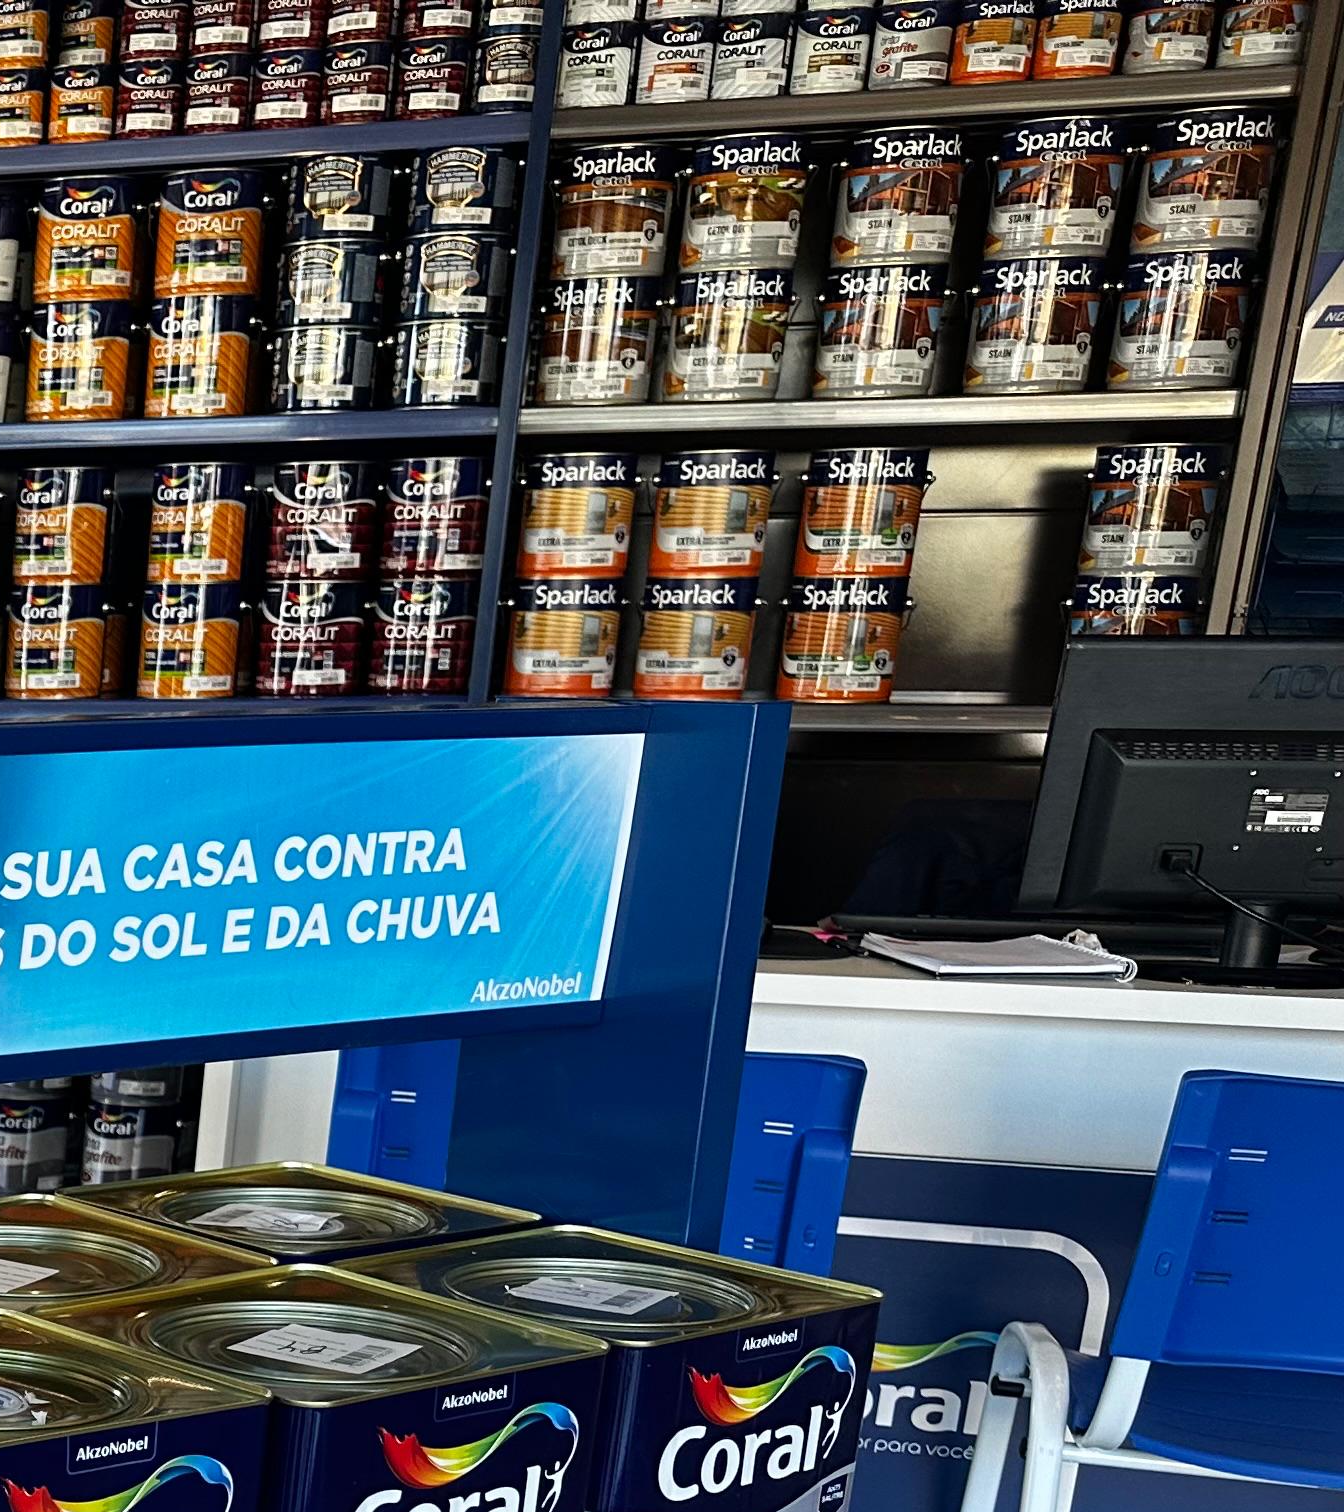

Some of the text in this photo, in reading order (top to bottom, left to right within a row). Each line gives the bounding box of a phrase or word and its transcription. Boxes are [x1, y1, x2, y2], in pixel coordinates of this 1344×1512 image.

[404, 65, 451, 82] CORALIT
[1015, 124, 1114, 156] Sparlack
[1176, 114, 1276, 148] Sparlack
[572, 151, 657, 182] Sparlack
[711, 139, 801, 170] Sparlack
[59, 195, 112, 216] Coral
[184, 187, 232, 209] Coral
[50, 221, 121, 242] CORALIT
[175, 215, 245, 235] CORALIT
[540, 459, 627, 487] Sparlack
[0, 847, 106, 900] SUA
[122, 837, 258, 892] CASA
[273, 826, 467, 882] CONTRA
[19, 918, 97, 972] DO
[108, 911, 207, 964] SOL
[221, 908, 254, 954] E
[265, 900, 332, 949] DA
[346, 890, 501, 943] CHUVA
[470, 971, 582, 1004] AkzoNobel
[658, 1403, 816, 1502] Coral
[875, 1439, 974, 1461] para você
